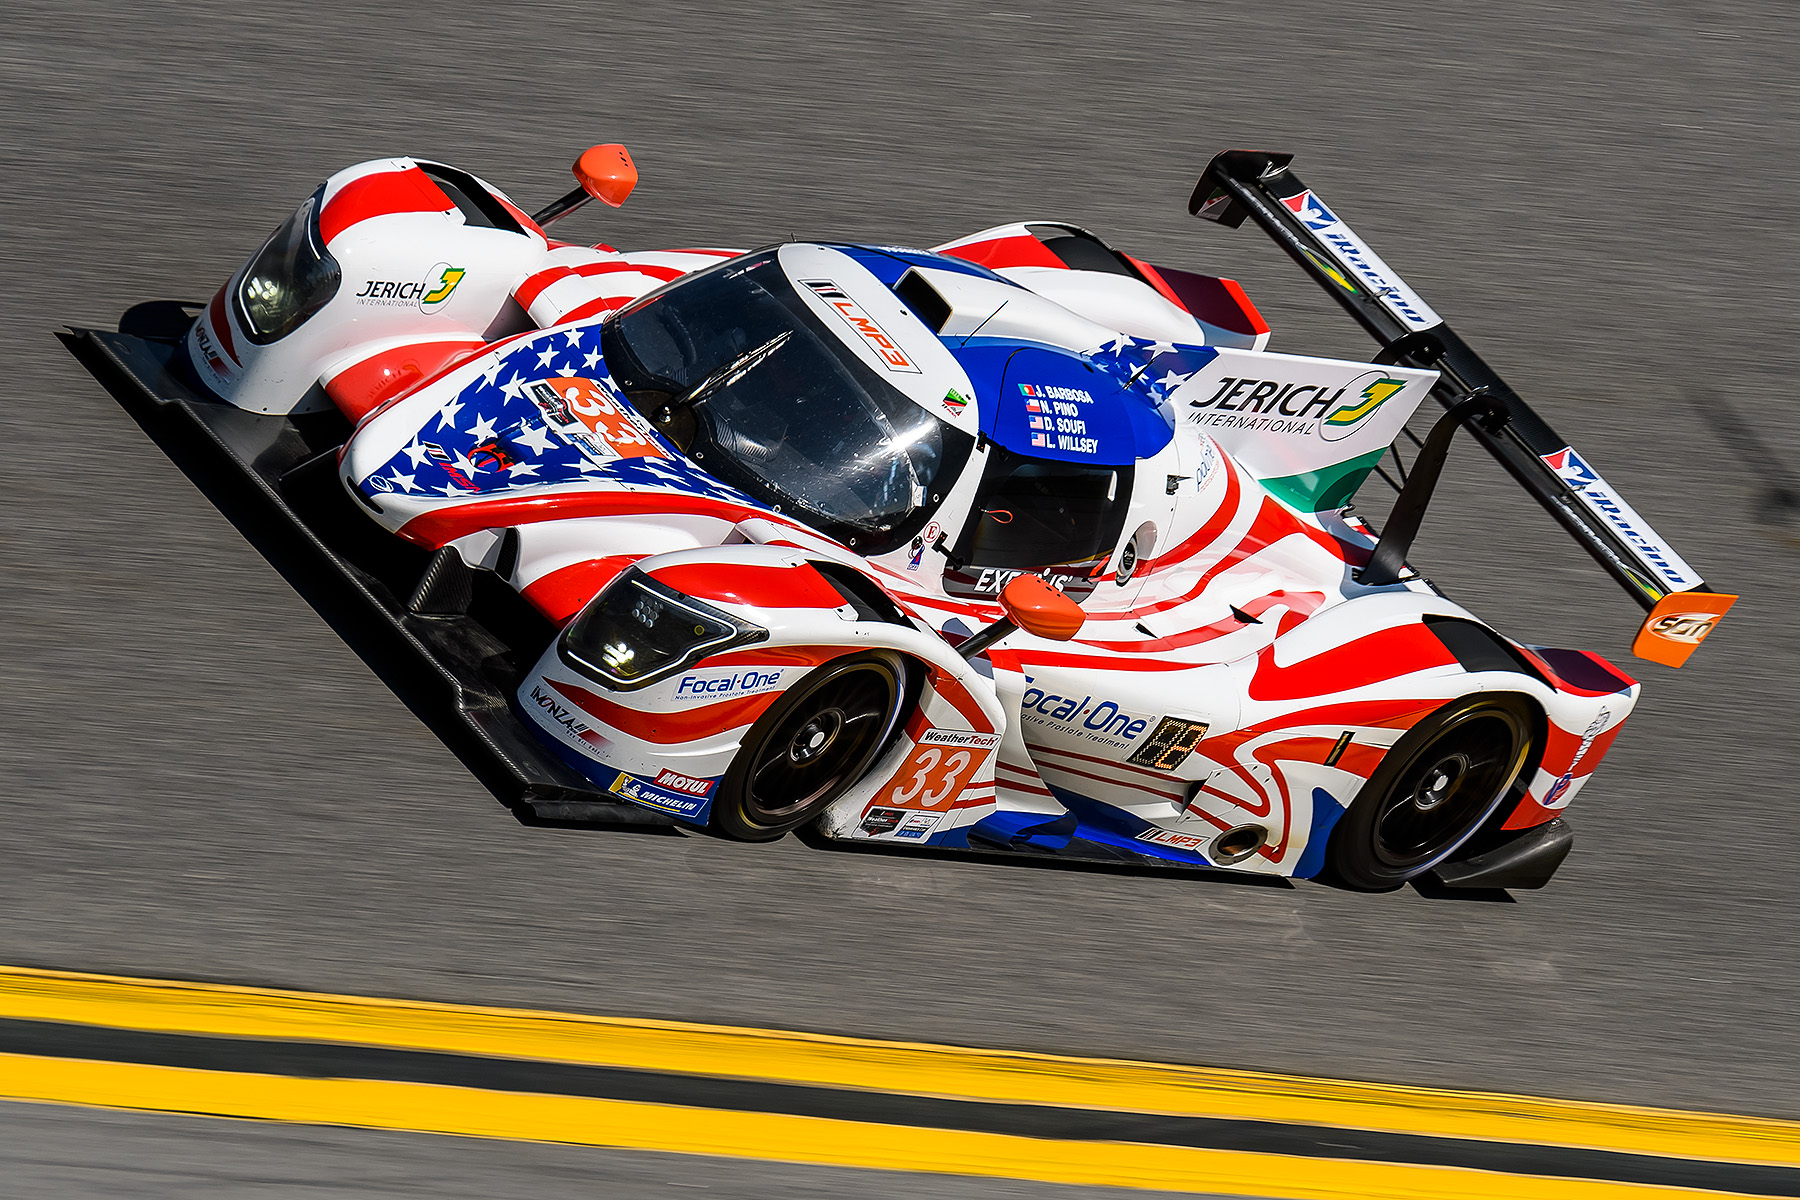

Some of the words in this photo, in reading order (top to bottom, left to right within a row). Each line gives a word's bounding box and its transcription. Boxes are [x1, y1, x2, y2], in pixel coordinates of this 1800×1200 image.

[356, 281, 426, 299] JERICH
[357, 299, 418, 308] INTERNATIONAL
[832, 302, 910, 367] LMP3
[1035, 385, 1046, 398] J.
[1045, 386, 1094, 404] BARBOSA
[1189, 377, 1347, 419] JERICH
[565, 387, 647, 446] 33
[1040, 400, 1052, 414] N.
[1053, 402, 1079, 417] PINO
[1044, 417, 1055, 431] D.
[1057, 418, 1086, 435] SOUFI
[1188, 411, 1316, 435] INTERNATIONAL
[1047, 434, 1056, 449] L.
[1058, 435, 1098, 454] WILLSEY
[924, 731, 996, 746] WeatherTech
[1046, 721, 1083, 737] Prostate
[1085, 732, 1130, 750] Treatment
[658, 772, 709, 794] MOTUL
[891, 748, 971, 807] 33
[640, 791, 697, 811] MICHELIN
[1155, 832, 1203, 847] LMP3
